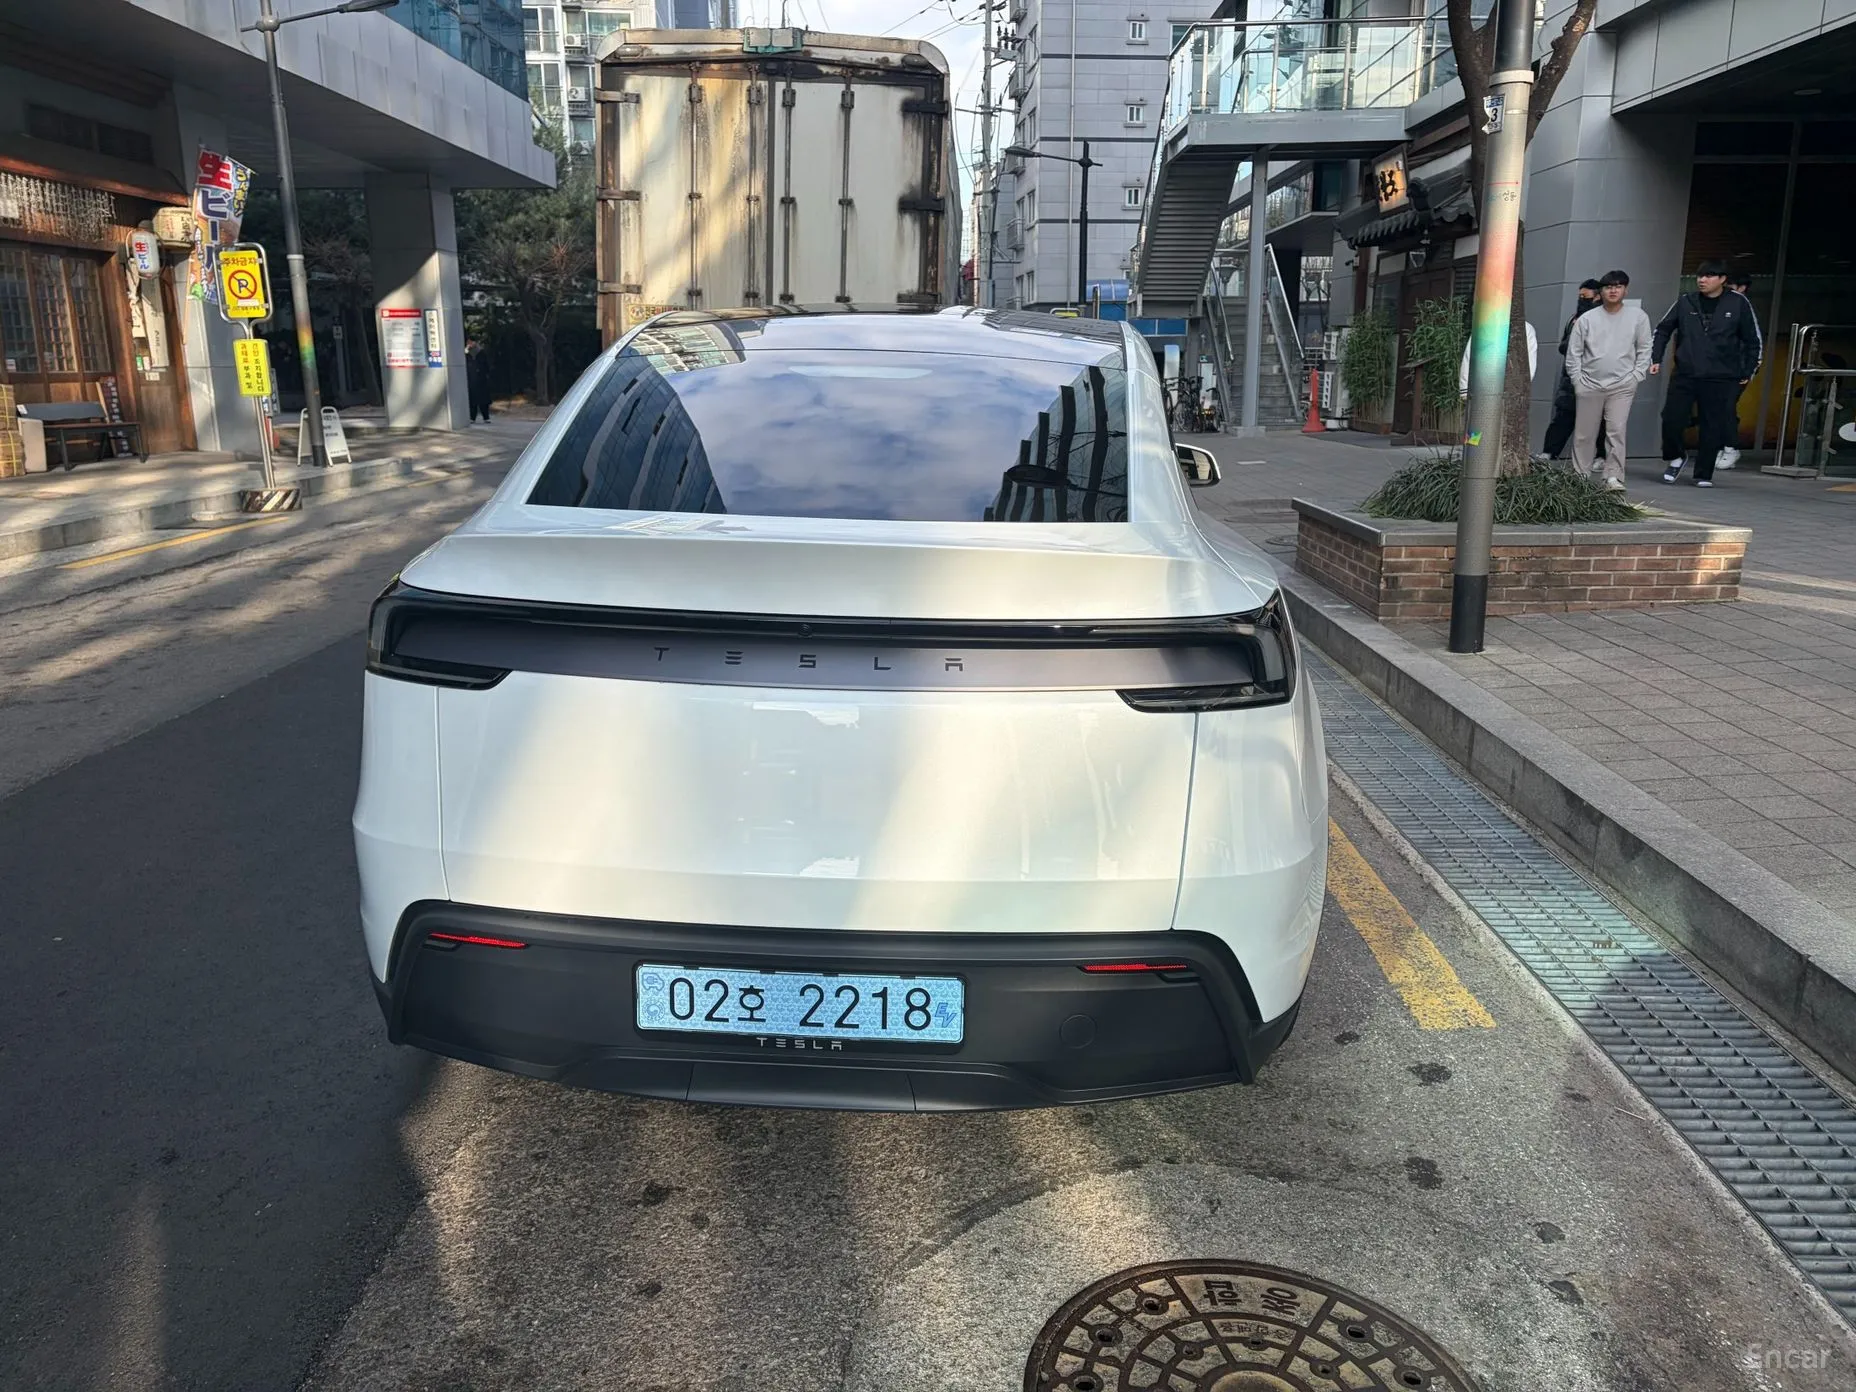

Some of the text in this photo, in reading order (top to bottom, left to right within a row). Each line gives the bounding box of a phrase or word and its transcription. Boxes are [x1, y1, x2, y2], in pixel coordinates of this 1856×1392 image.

[653, 647, 964, 672] TESLA
[669, 977, 932, 1031] 02호 2218
[935, 1002, 957, 1028] EV
[756, 1037, 842, 1051] TESLA
